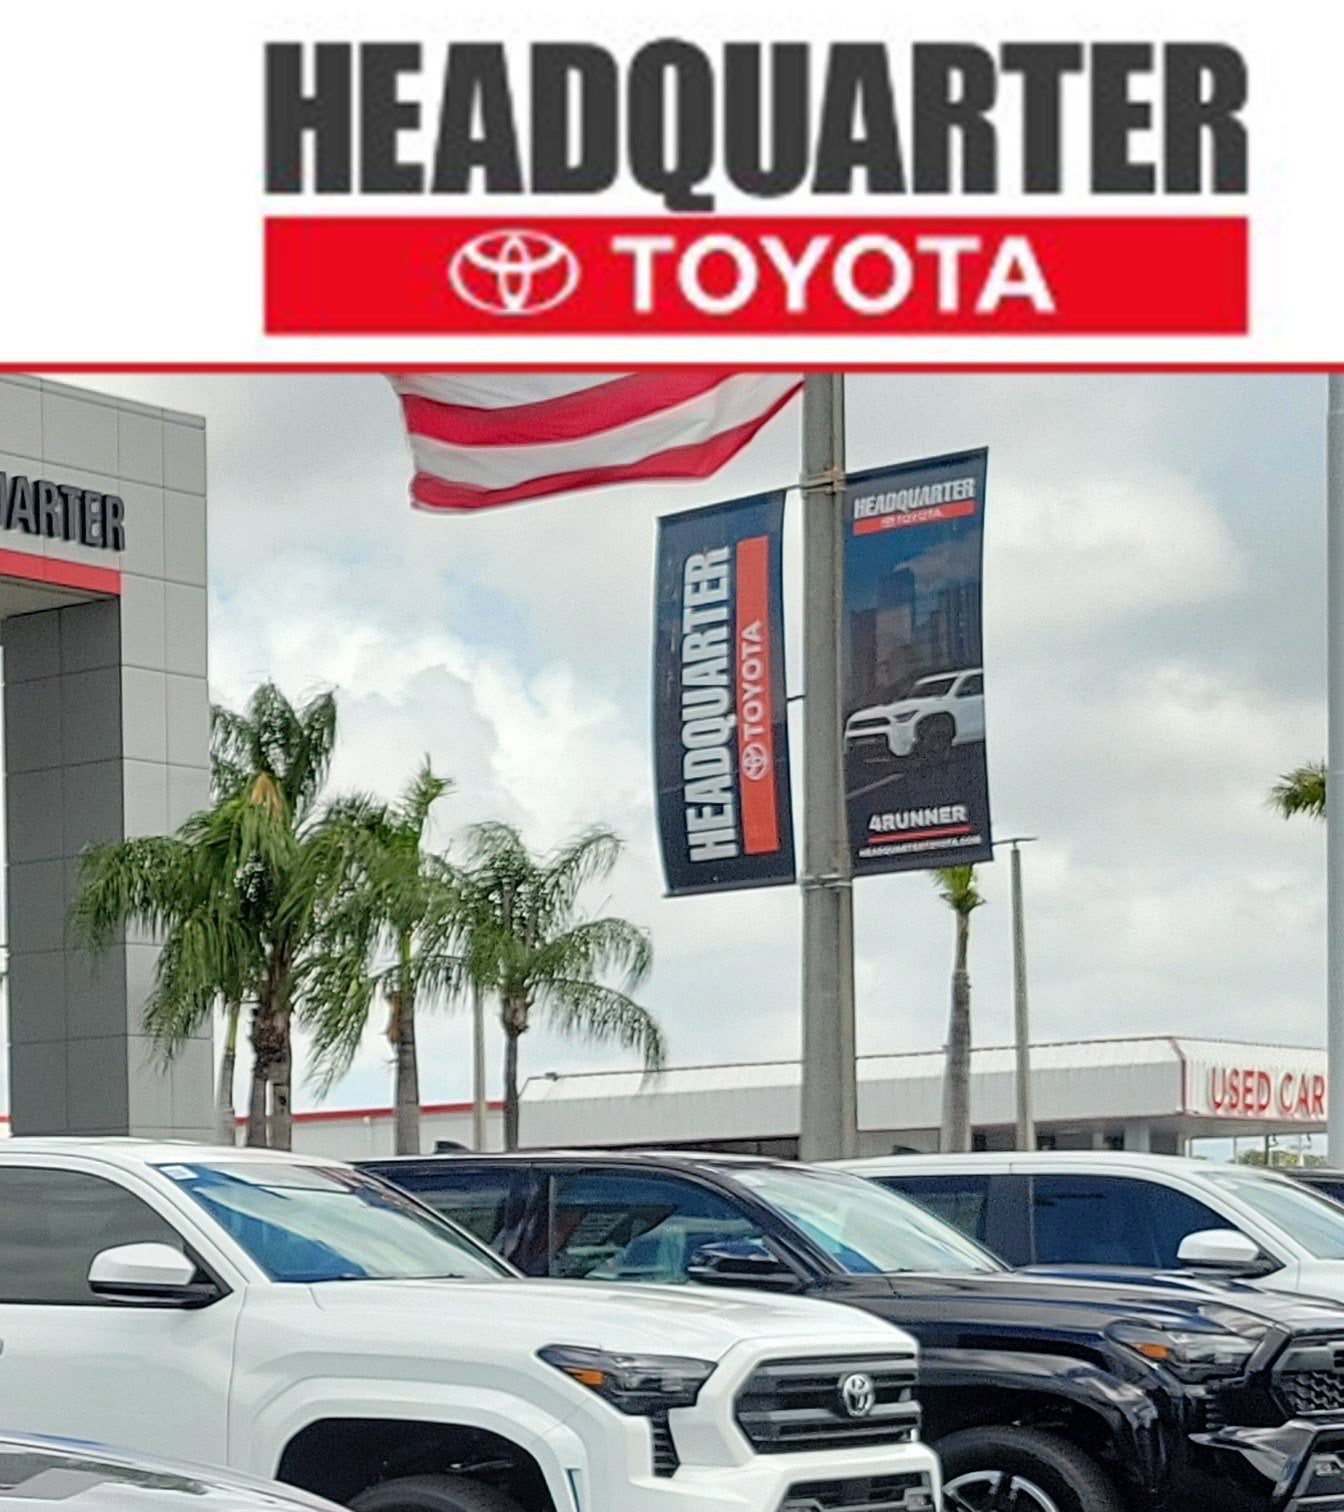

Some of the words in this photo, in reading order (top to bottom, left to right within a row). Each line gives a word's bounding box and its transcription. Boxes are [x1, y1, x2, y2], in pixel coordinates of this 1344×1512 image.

[853, 477, 976, 519] HEADQUARTER
[682, 545, 739, 863] HEADQUARTER
[741, 620, 764, 742] TOYOTA
[868, 804, 967, 833] 4RUNNER
[1210, 1066, 1272, 1111] USED
[1280, 1072, 1325, 1115] CAR
